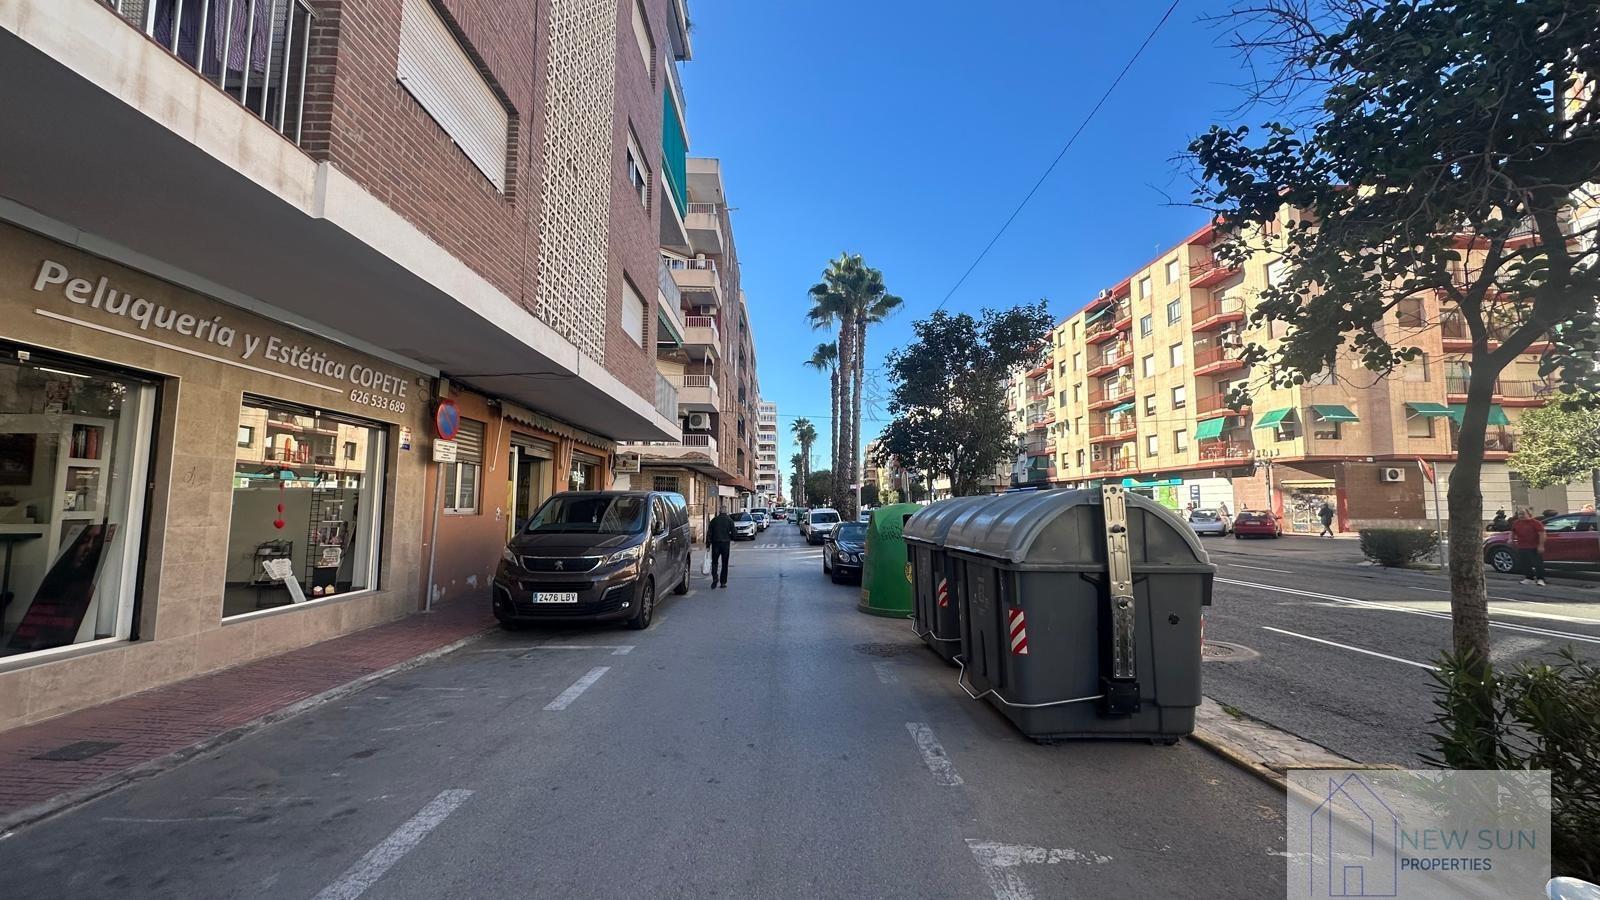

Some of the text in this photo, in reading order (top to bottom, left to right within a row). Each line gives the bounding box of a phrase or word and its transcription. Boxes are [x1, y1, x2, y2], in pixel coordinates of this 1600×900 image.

[34, 259, 409, 398] Peluquería y Estética COPETE
[350, 389, 406, 413] 626 533 689
[539, 593, 559, 602] 2476
